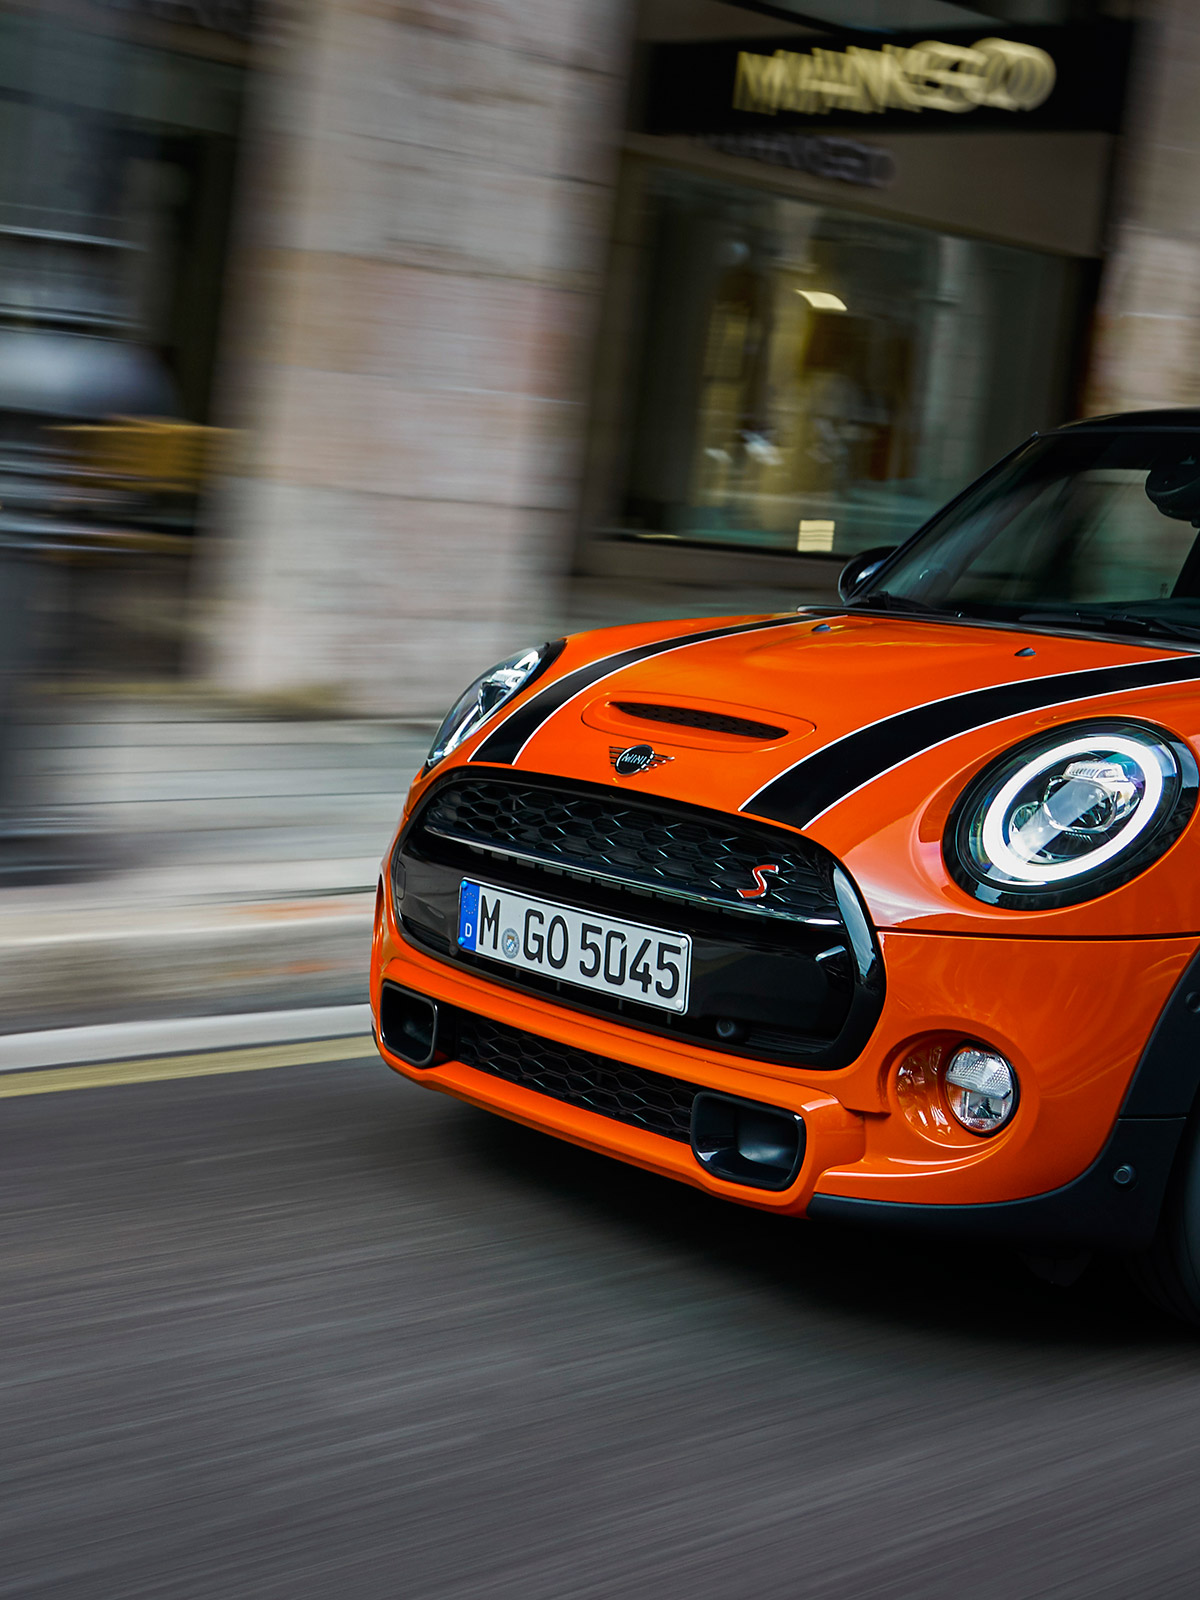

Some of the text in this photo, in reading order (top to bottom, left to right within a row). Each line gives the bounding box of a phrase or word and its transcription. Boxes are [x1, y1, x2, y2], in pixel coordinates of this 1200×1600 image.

[621, 753, 648, 765] MINI
[736, 864, 779, 898] S
[464, 923, 473, 938] D
[479, 895, 501, 950] M
[523, 908, 570, 970] GO
[579, 922, 682, 999] 5045
